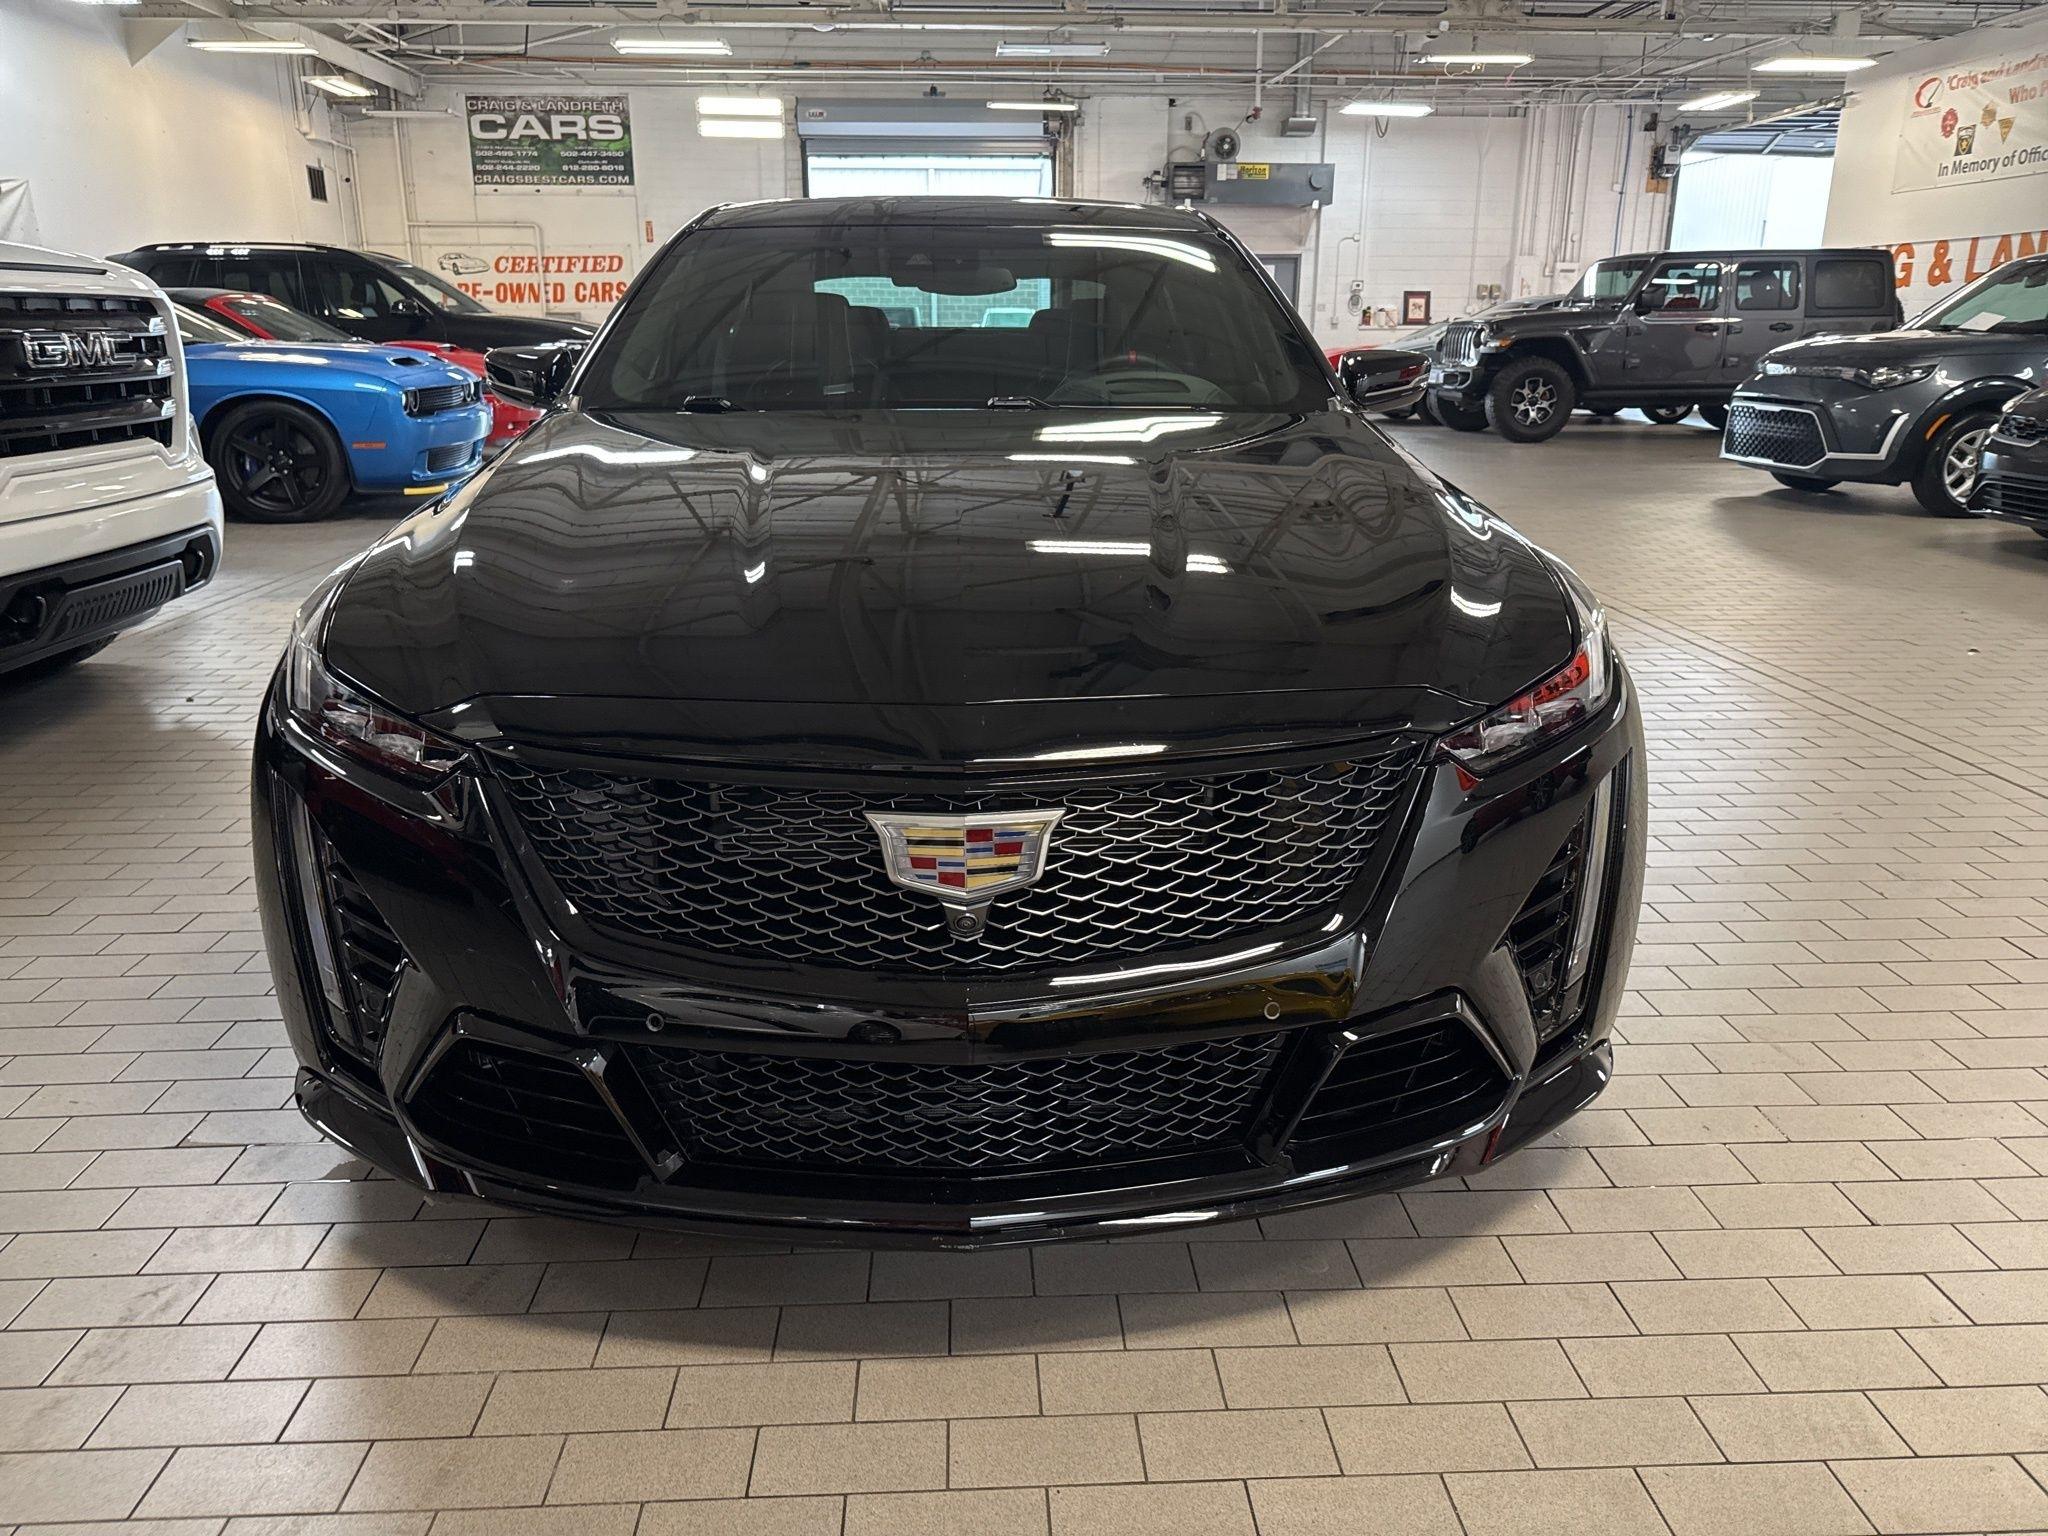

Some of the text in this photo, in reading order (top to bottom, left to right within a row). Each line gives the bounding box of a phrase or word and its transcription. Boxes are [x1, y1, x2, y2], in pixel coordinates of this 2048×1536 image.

[466, 101, 624, 112] CRAIG & LANDRETH
[469, 114, 624, 140] CARS
[1937, 162, 1949, 177] In
[1950, 156, 2000, 175] Memory
[2002, 149, 2018, 169] of
[474, 175, 630, 184] CRAIGSBESTCARS.COM
[494, 255, 624, 274] CERTIFIED
[443, 281, 628, 304] RE-OWNED CARS
[22, 331, 138, 369] GMC
